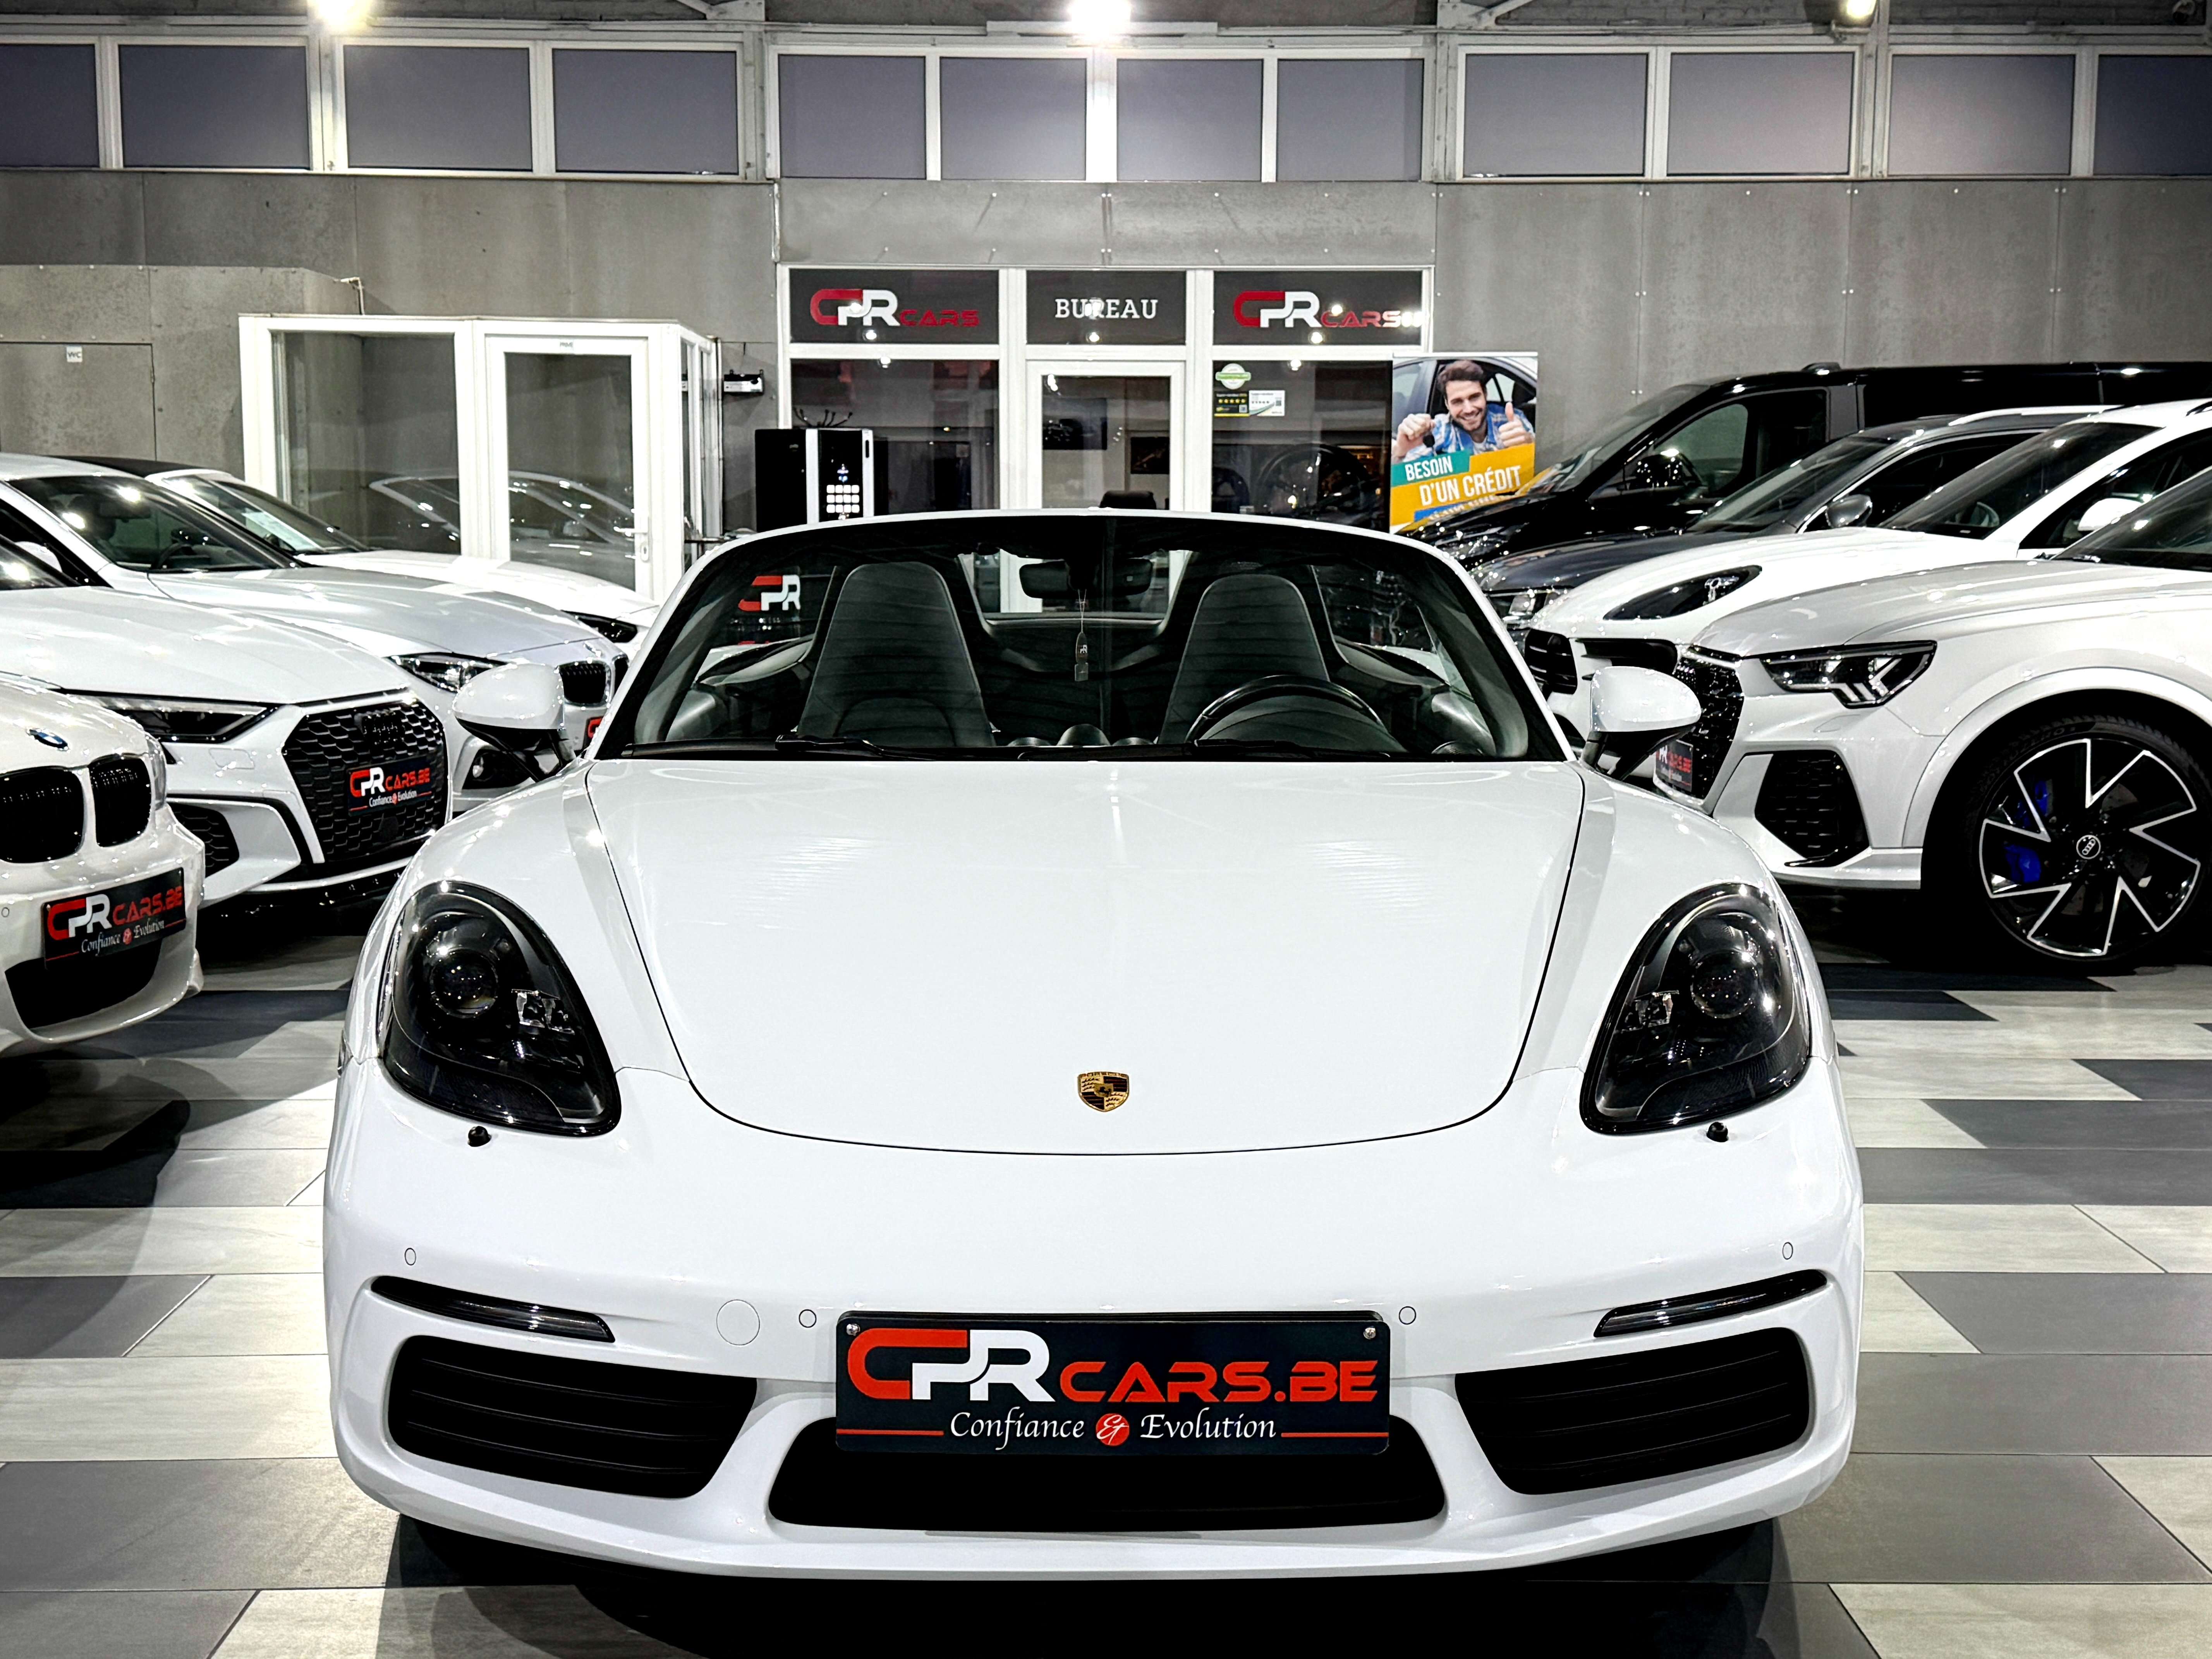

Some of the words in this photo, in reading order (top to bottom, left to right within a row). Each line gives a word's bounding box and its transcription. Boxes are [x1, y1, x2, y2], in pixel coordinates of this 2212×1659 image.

[810, 289, 900, 326] CPR
[900, 309, 980, 327] CARS
[1055, 298, 1158, 319] BUREAU
[1233, 291, 1322, 328] CPR
[1320, 310, 1401, 328] CARS
[1405, 455, 1453, 481] BESOIN
[1419, 477, 1460, 506] D'UN
[1463, 465, 1522, 496] CRÉDIT
[350, 767, 386, 797] CPR
[385, 768, 430, 791] CARS.BE
[47, 894, 112, 940] CPR
[113, 886, 183, 926] CARS.BE
[81, 931, 121, 957] Confiance
[847, 1328, 1056, 1402] CPR
[1060, 1360, 1379, 1402] CARS.BE
[950, 1406, 1084, 1451] Confiance
[1140, 1407, 1276, 1439] Evolution
